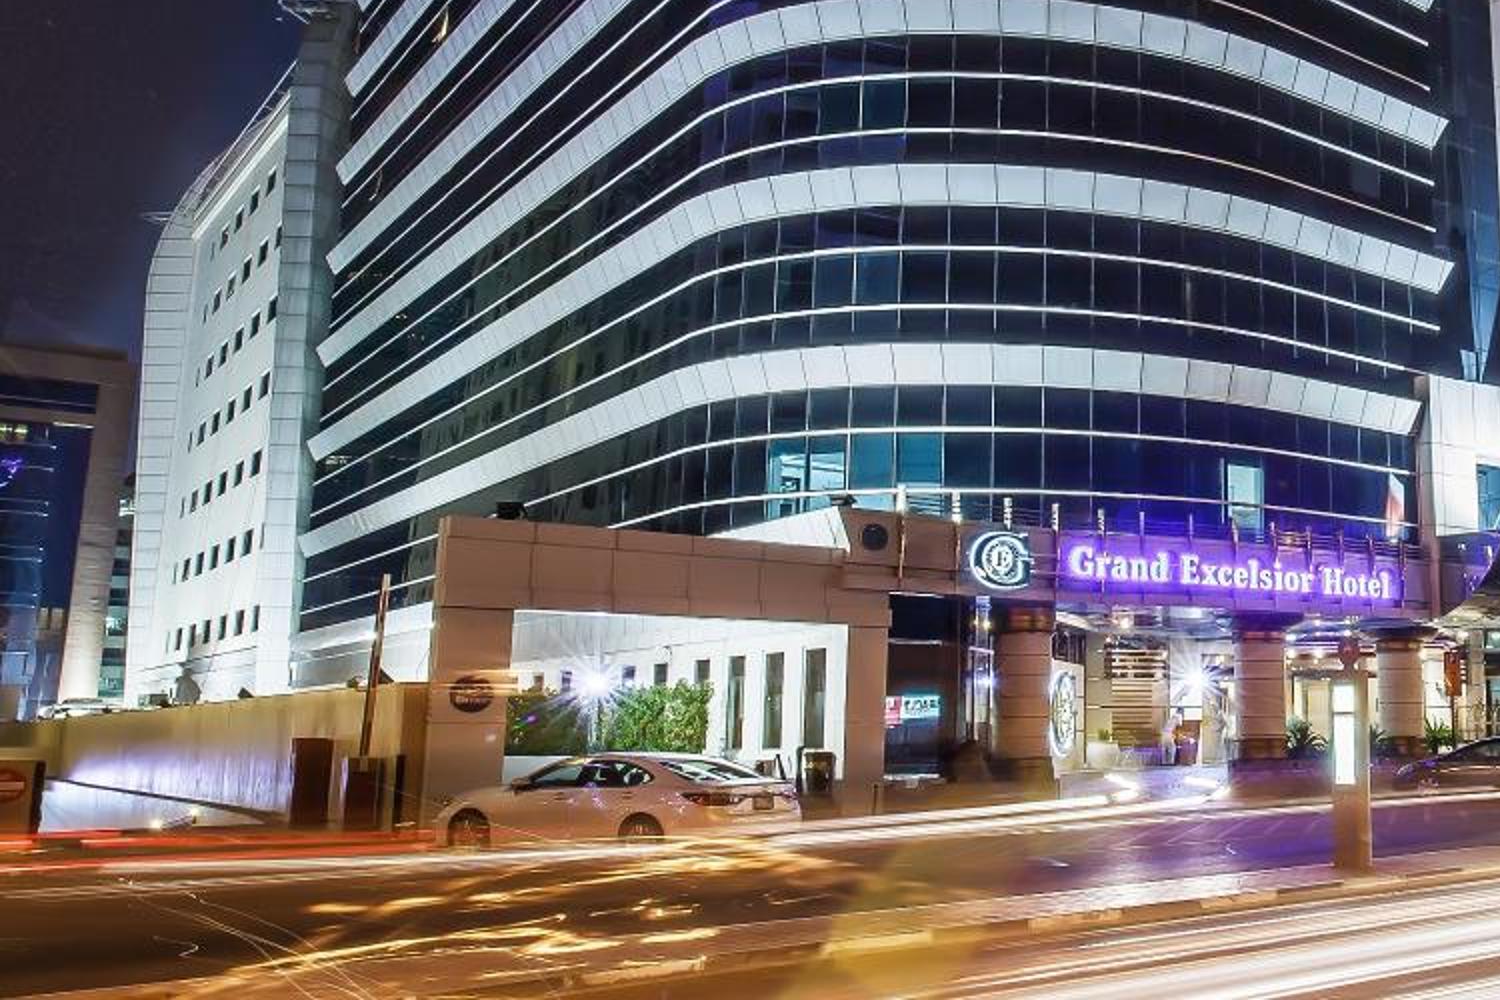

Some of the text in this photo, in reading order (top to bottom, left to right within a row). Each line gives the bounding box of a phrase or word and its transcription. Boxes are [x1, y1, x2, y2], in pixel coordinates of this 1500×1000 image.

[1069, 544, 1392, 599] Grand Excelsior Hotel
